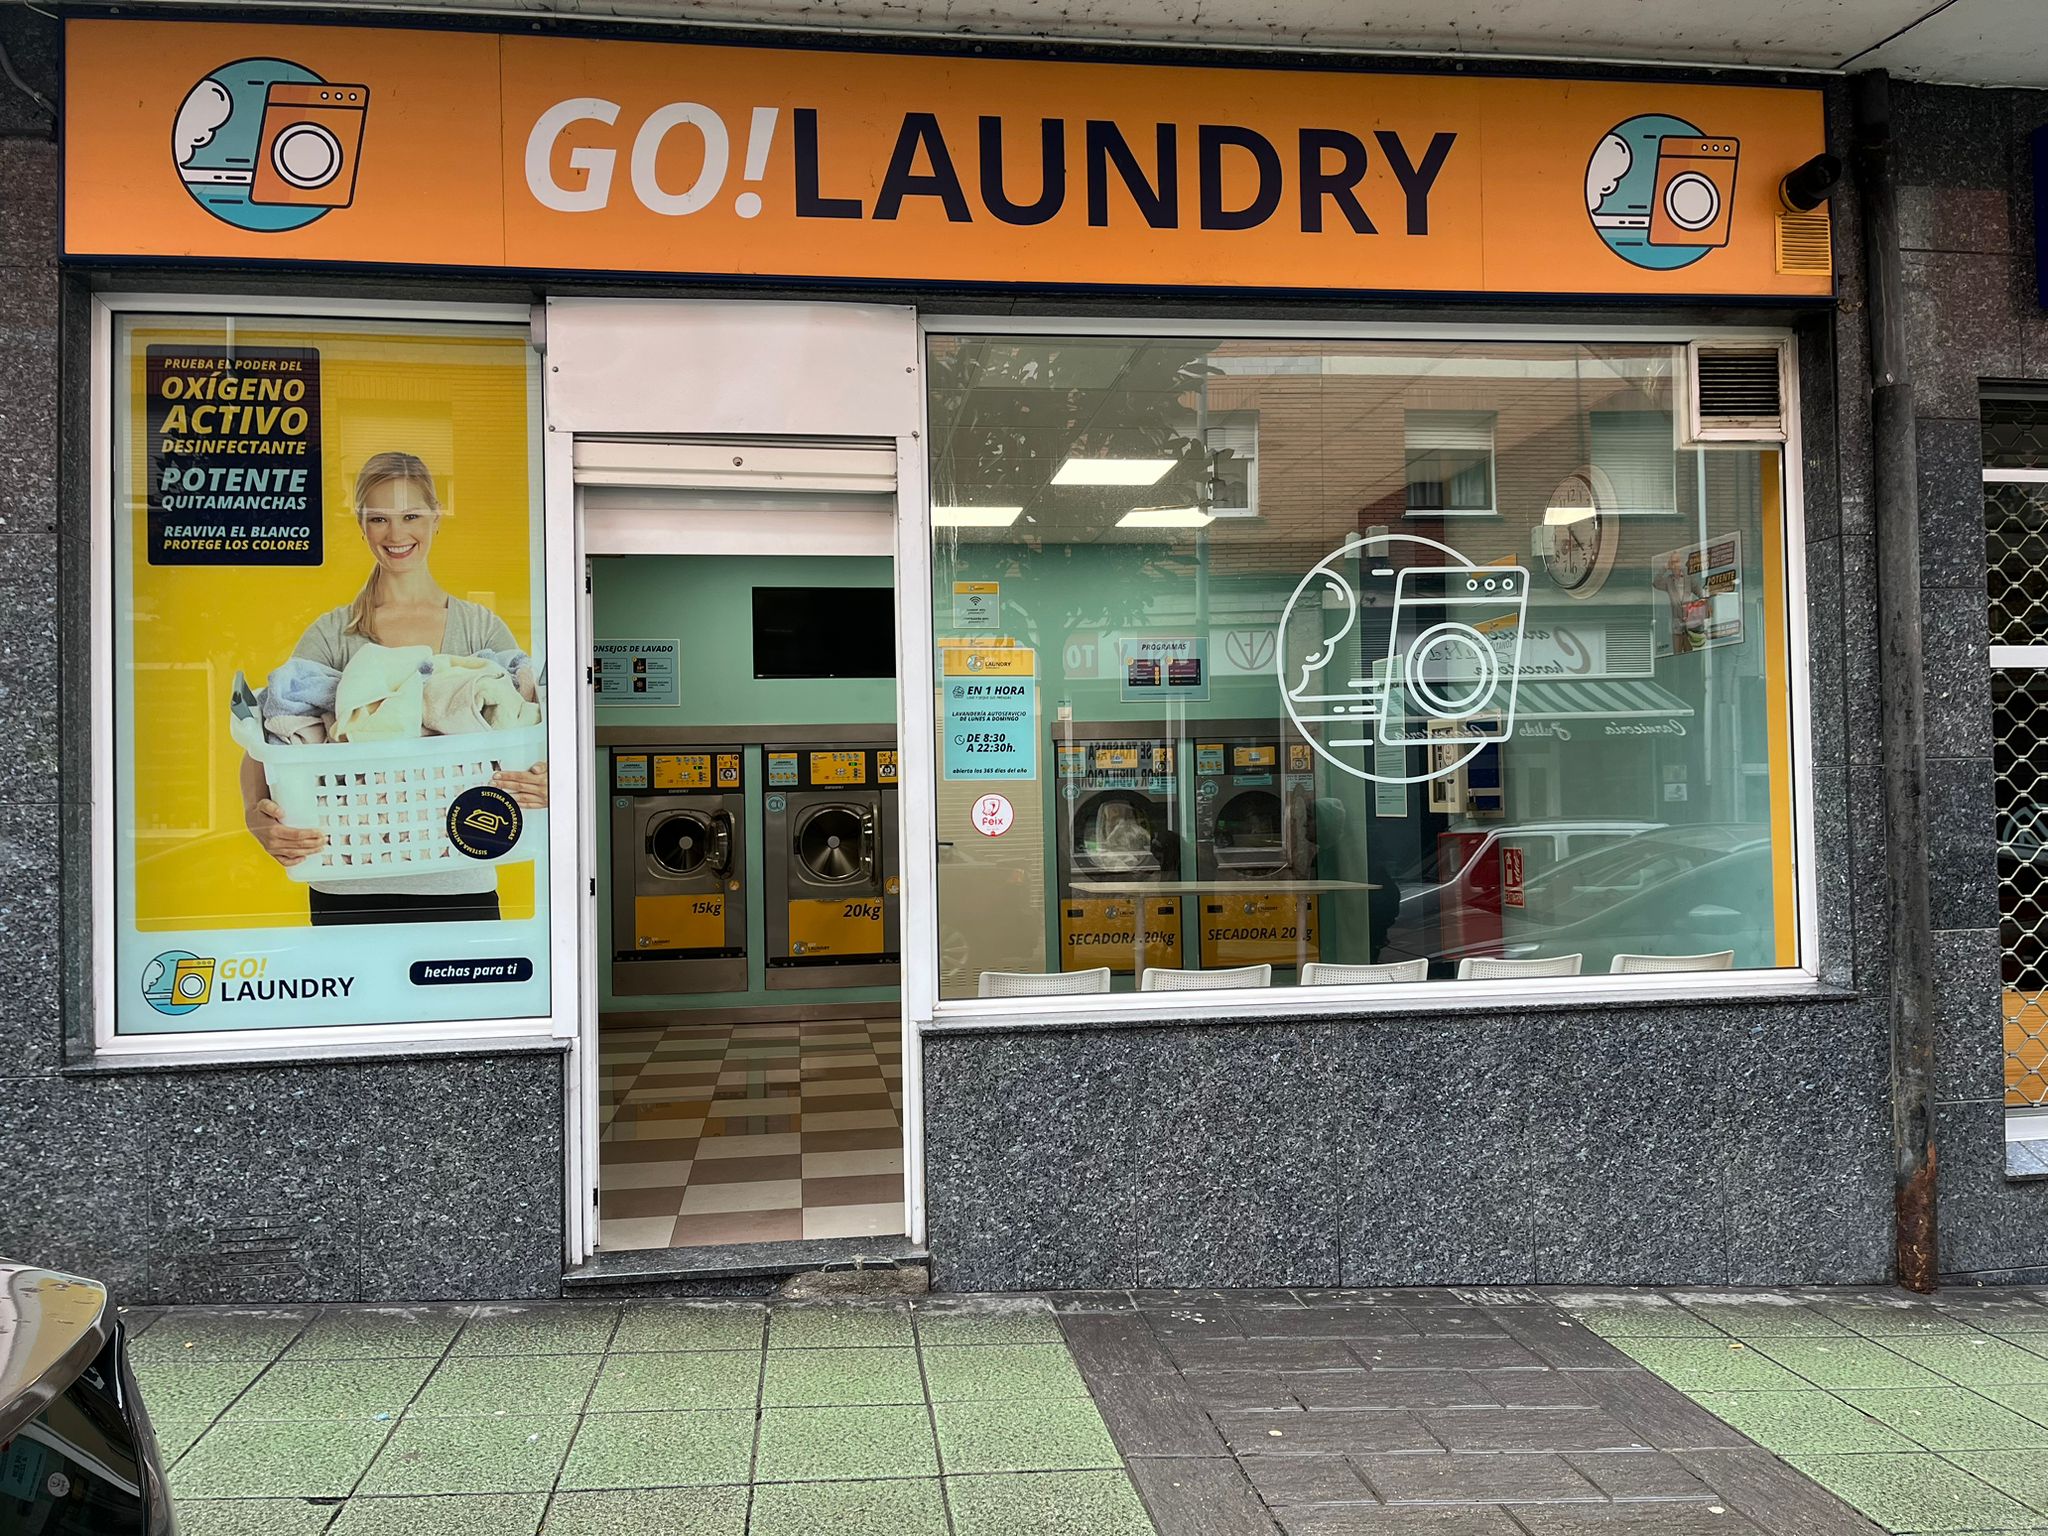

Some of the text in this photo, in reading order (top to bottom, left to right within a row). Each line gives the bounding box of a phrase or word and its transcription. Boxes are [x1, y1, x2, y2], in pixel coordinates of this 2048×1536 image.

[164, 358, 302, 371] PRUEBA EL PODER DEL
[161, 372, 306, 402] OXÍGENO
[159, 404, 309, 436] ACTIVO
[161, 439, 307, 455] DESINFECTANTE
[160, 467, 308, 493] POTENTE
[161, 495, 307, 511] QUITAMANCHAS
[164, 525, 310, 538] REAVIVA EL BLANCO
[163, 540, 310, 551] PROTEGE LOS COLORES
[593, 645, 673, 654] ONSEJOS DE LAVADO
[1142, 643, 1187, 651] PROGRAMAS
[967, 686, 1025, 695] EN 1 HORA
[967, 733, 1006, 742] DE 8:30
[966, 743, 1016, 753] A 22:30h.
[691, 902, 722, 917] 15kg
[843, 903, 882, 921] 20kg
[1144, 931, 1175, 946] 20kg
[1208, 926, 1313, 941] SECADORA 20g
[219, 957, 268, 980] GO!
[424, 962, 518, 981] hechas para ti
[220, 976, 355, 1002] LAUNDRY
